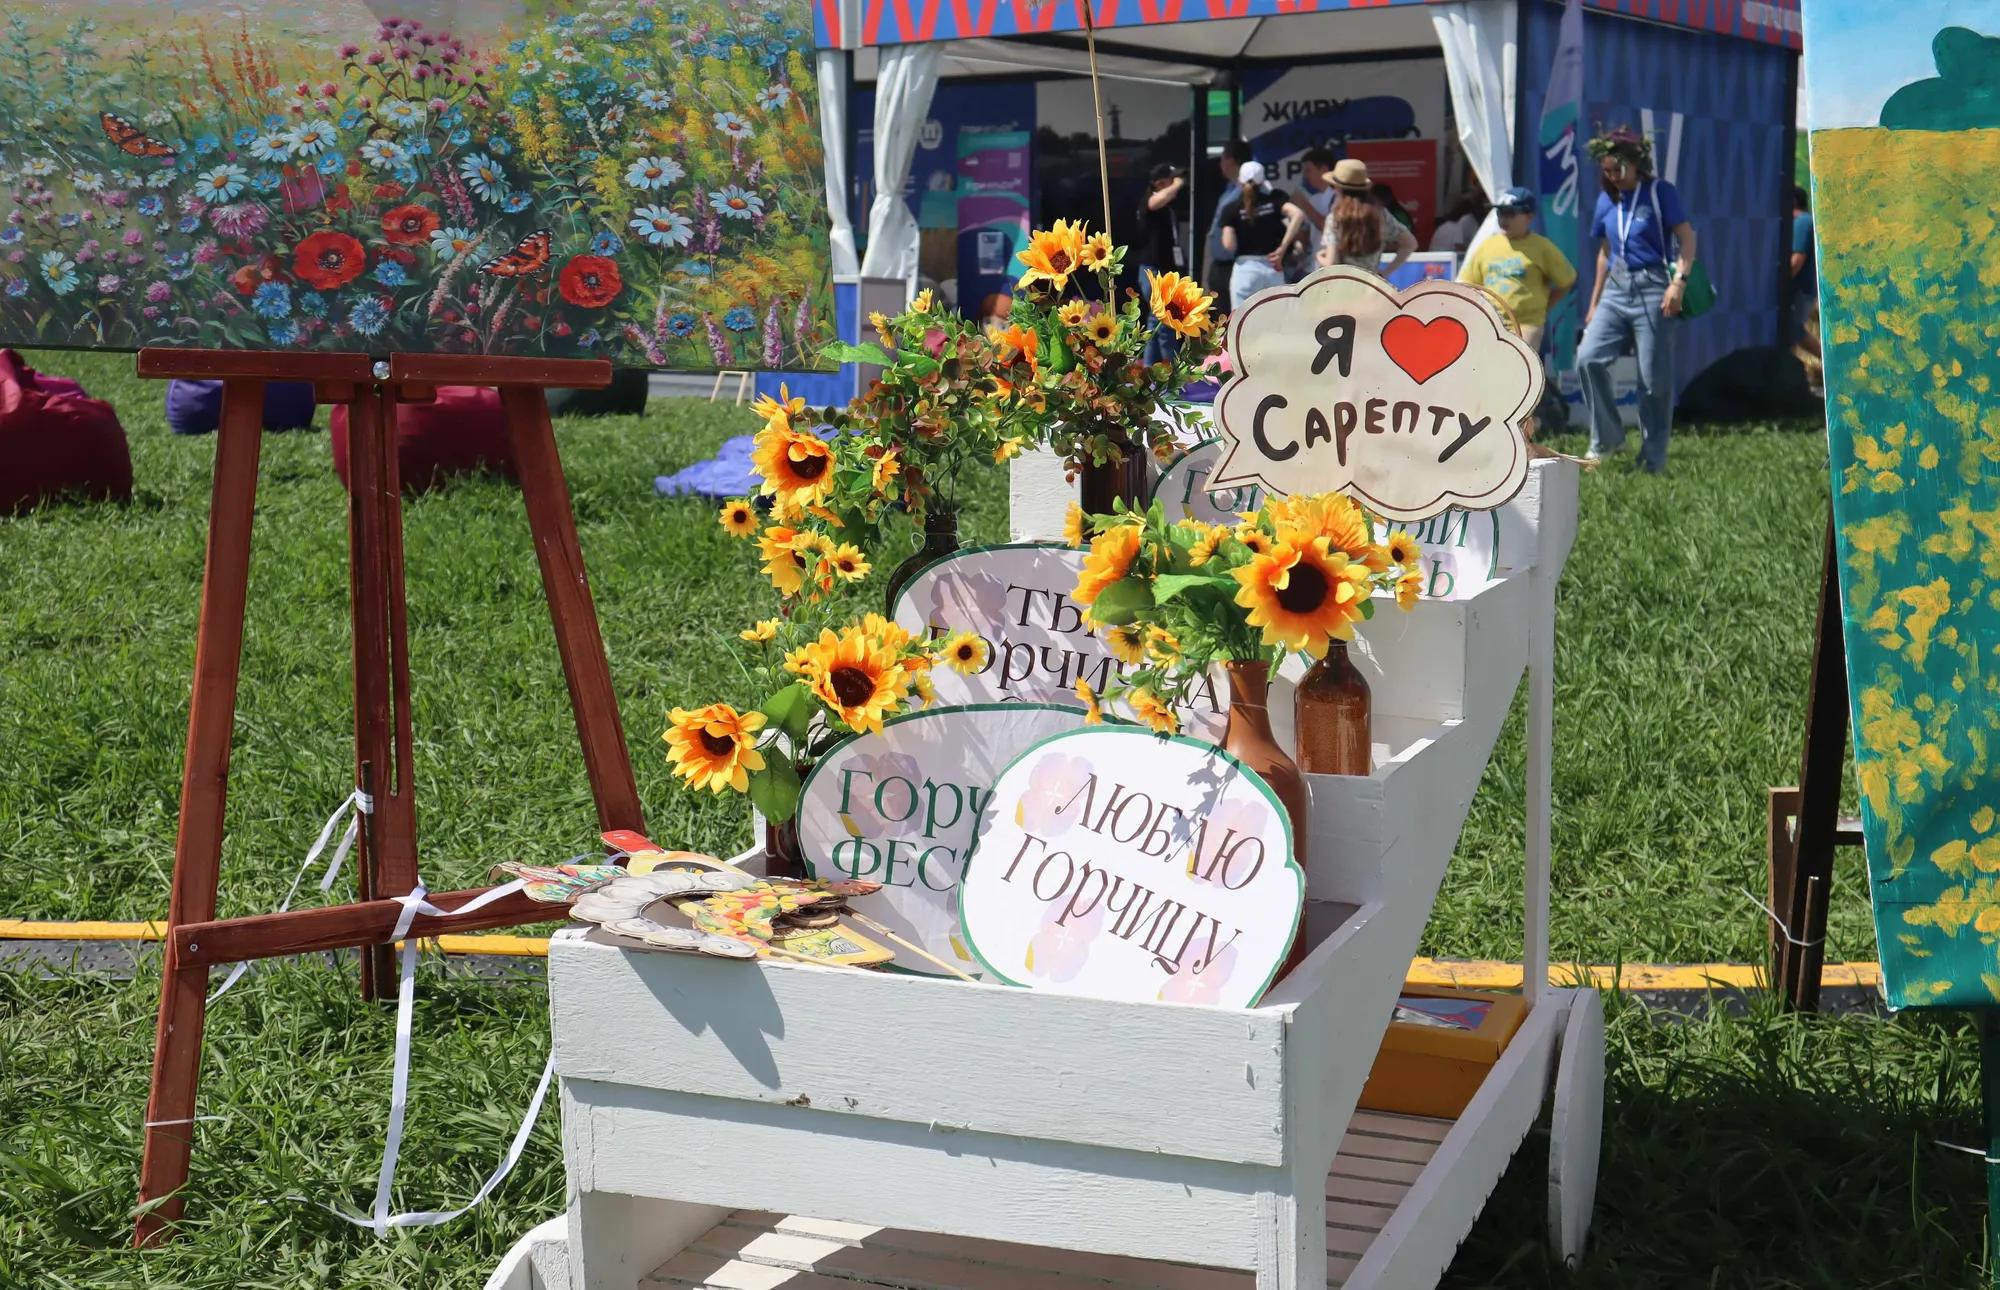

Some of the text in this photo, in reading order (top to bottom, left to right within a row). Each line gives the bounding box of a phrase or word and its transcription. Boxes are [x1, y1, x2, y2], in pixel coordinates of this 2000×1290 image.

[1311, 315, 1356, 378] Я
[1054, 772, 1265, 891] ЛЮБЛЮ
[832, 836, 968, 892] ФЕС
